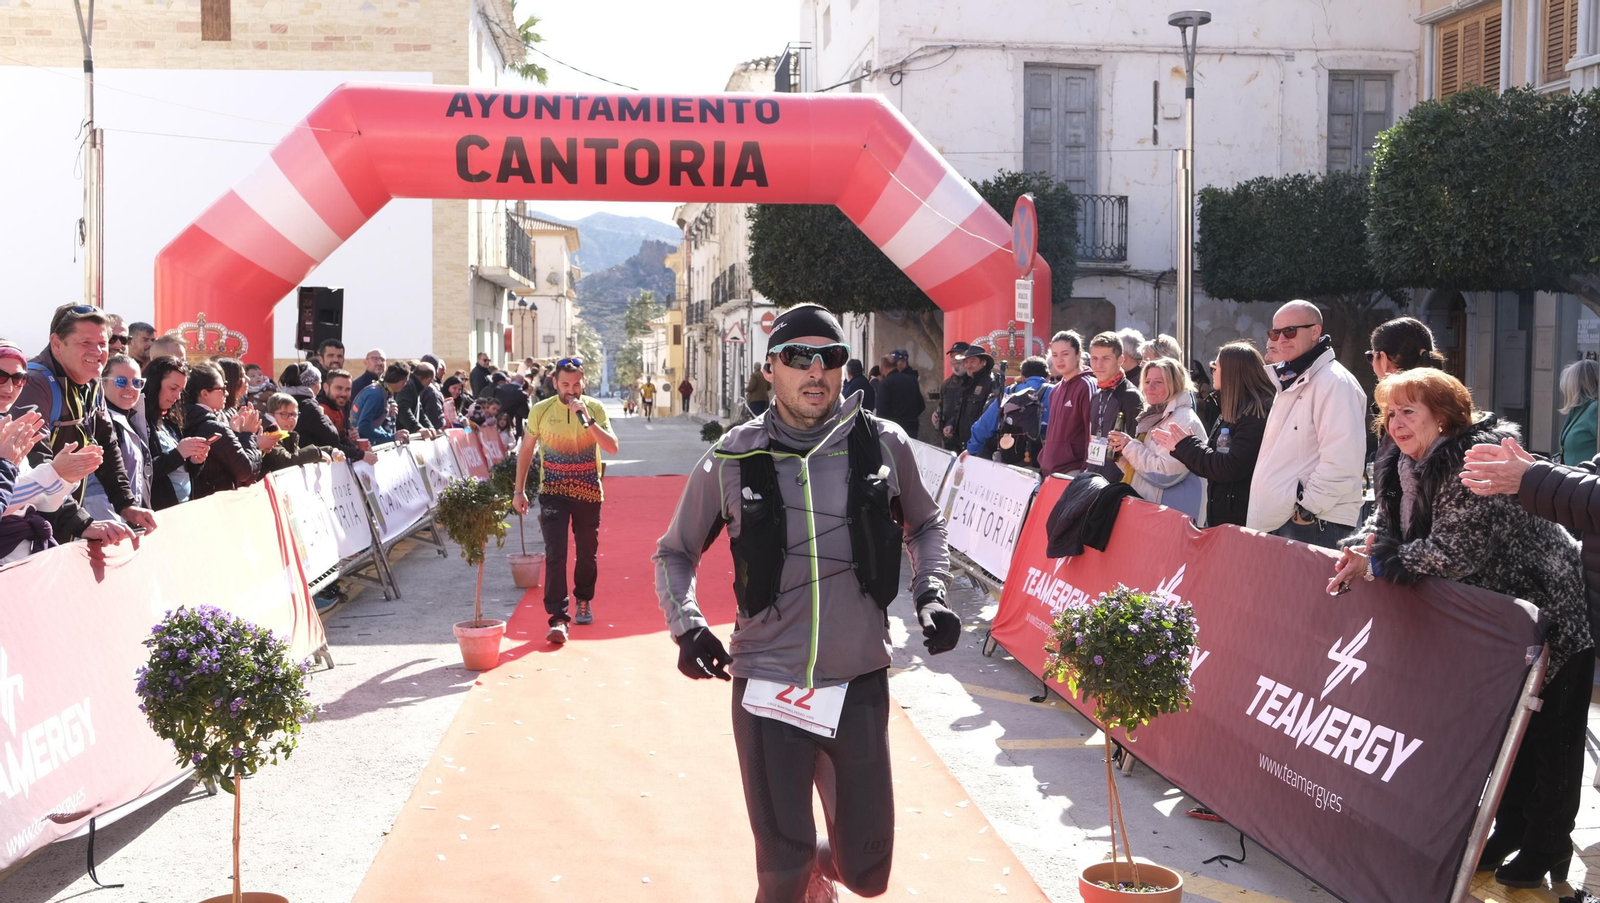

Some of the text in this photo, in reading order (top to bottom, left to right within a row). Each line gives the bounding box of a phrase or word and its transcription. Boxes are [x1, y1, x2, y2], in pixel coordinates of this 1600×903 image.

[446, 92, 780, 125] AYUNTAMIENTO
[455, 134, 769, 187] CANTORIA
[379, 478, 422, 516] CANTORIA
[963, 479, 1023, 518] AYUNTAMIENTO DE
[953, 496, 1018, 552] CANTORIA
[1022, 566, 1090, 613] TEAMERGY
[775, 684, 815, 711] 22
[1245, 675, 1424, 783] TEAMERGY
[1259, 752, 1343, 813] www.teamergy.es
